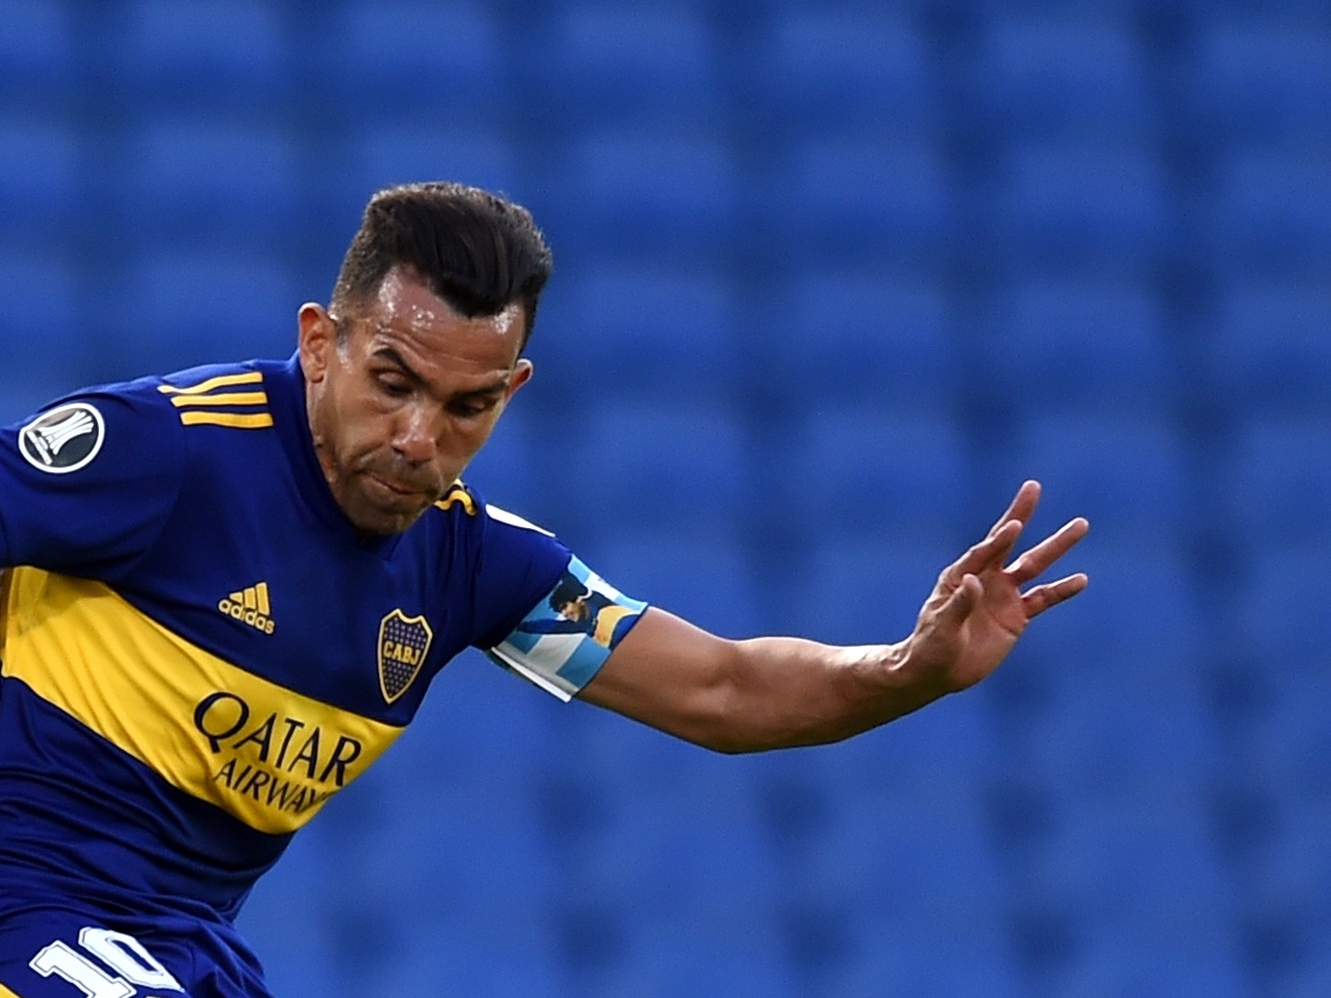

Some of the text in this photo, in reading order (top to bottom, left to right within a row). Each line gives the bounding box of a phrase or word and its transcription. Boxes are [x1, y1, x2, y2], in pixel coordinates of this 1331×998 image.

[218, 598, 276, 635] adidas
[383, 640, 421, 666] CABJ
[194, 691, 363, 787] QATAR
[211, 757, 338, 814] AIRWAY
